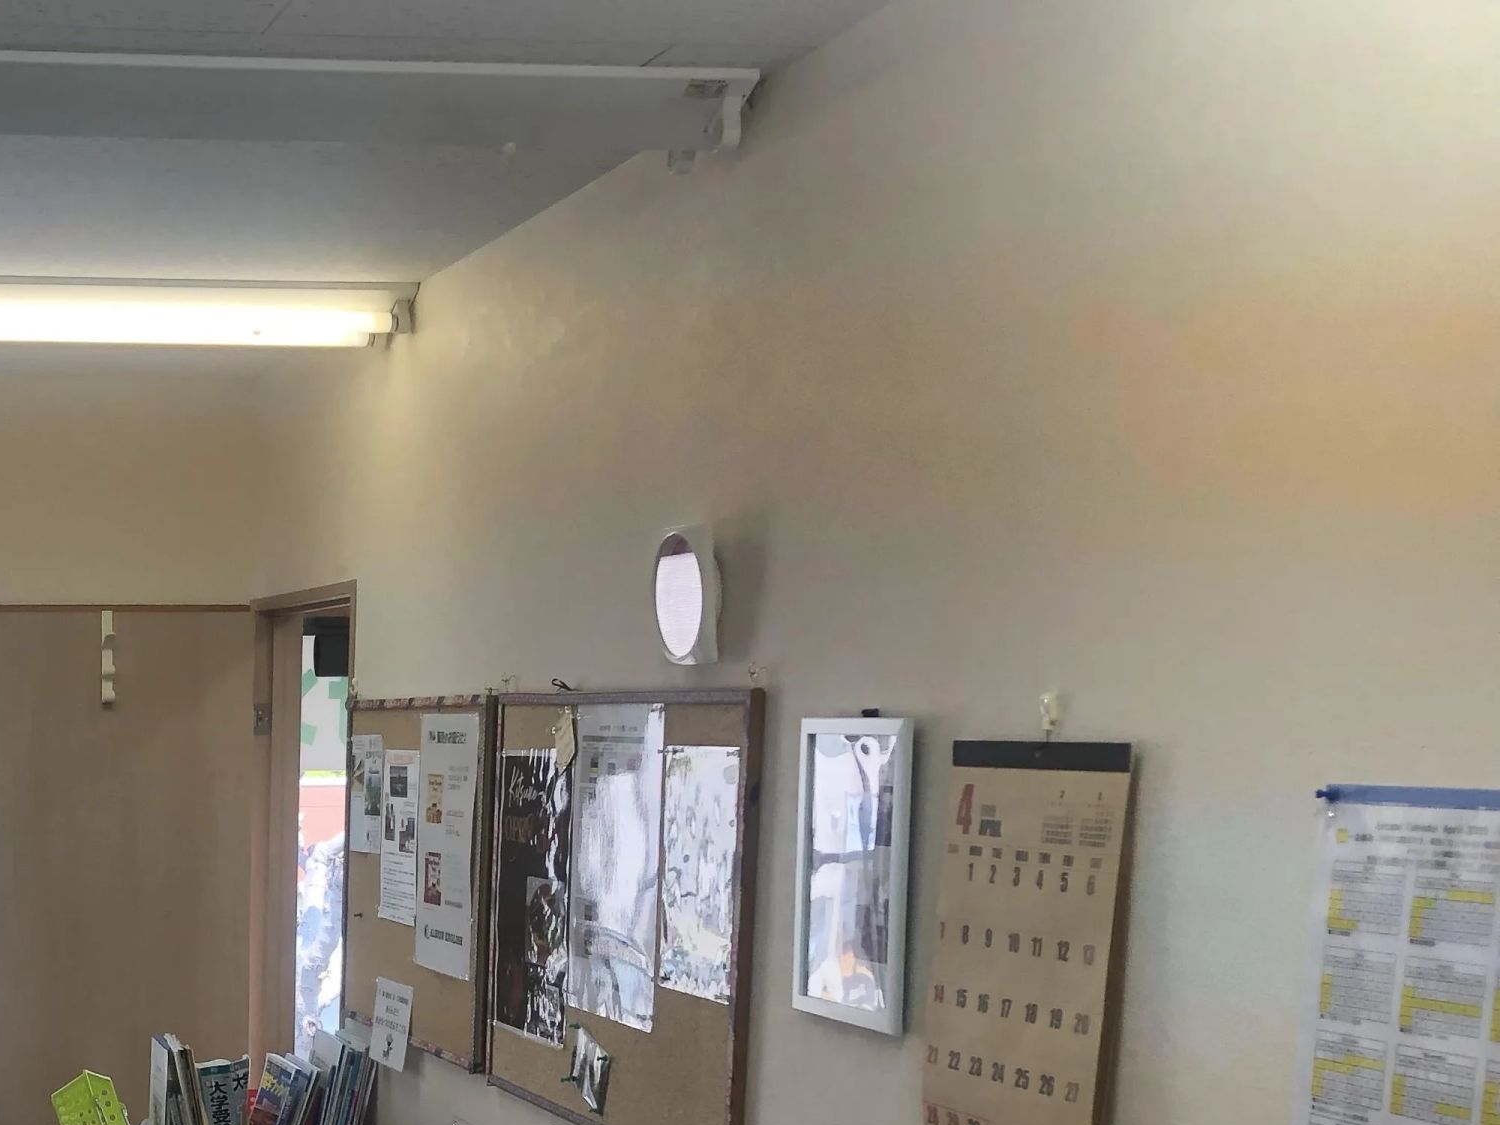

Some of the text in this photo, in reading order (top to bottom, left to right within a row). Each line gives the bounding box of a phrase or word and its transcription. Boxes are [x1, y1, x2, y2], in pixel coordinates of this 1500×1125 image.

[956, 784, 974, 834] 4
[968, 863, 1096, 896] 1 2 3 4 5 6
[939, 921, 945, 940] 7
[962, 925, 970, 945] 8
[985, 928, 993, 948] 9
[1008, 933, 1020, 953] 10
[1031, 937, 1043, 958] 11
[1057, 940, 1070, 962] 12
[934, 984, 1090, 1035] 14 15 16 17 18 19 20
[927, 1045, 938, 1065] 21
[948, 1050, 961, 1071] 22
[968, 1056, 983, 1077] 23
[991, 1062, 1005, 1084] 24
[1014, 1068, 1030, 1090] 25
[1038, 1074, 1055, 1096] 26
